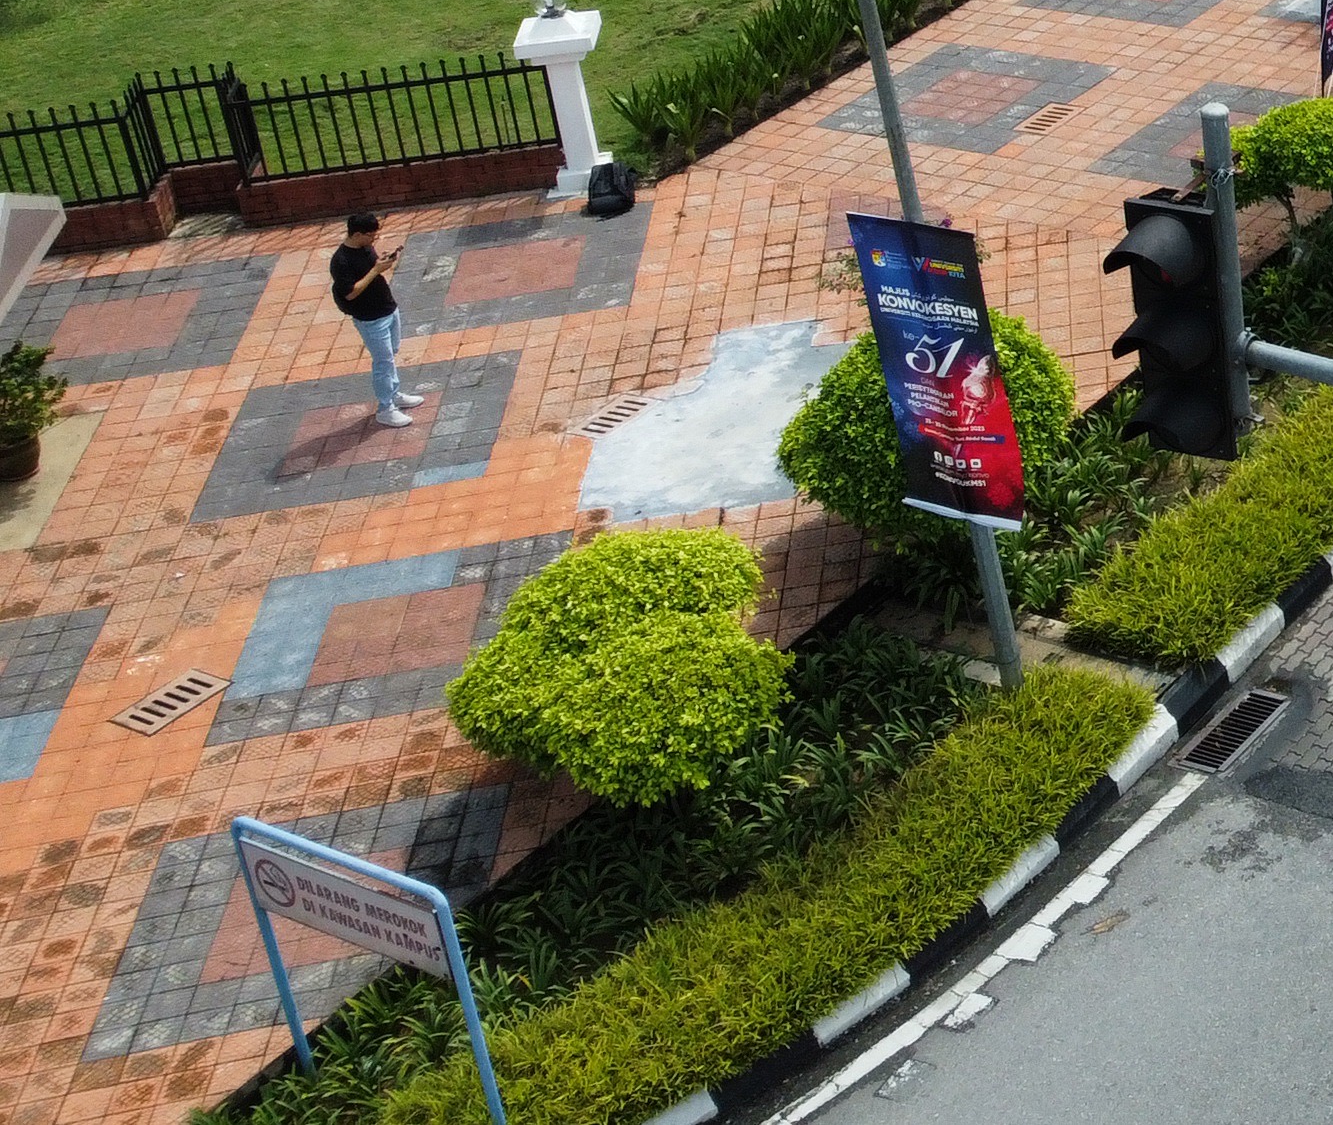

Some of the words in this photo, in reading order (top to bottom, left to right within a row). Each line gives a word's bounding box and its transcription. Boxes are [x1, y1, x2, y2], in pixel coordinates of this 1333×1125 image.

[877, 293, 979, 320] KONVOKESYEN
[905, 334, 965, 379] 51
[296, 876, 360, 912] DILARANG
[365, 902, 428, 938] MEROKOK
[302, 897, 317, 914] DI
[319, 903, 382, 940] KAWASAN
